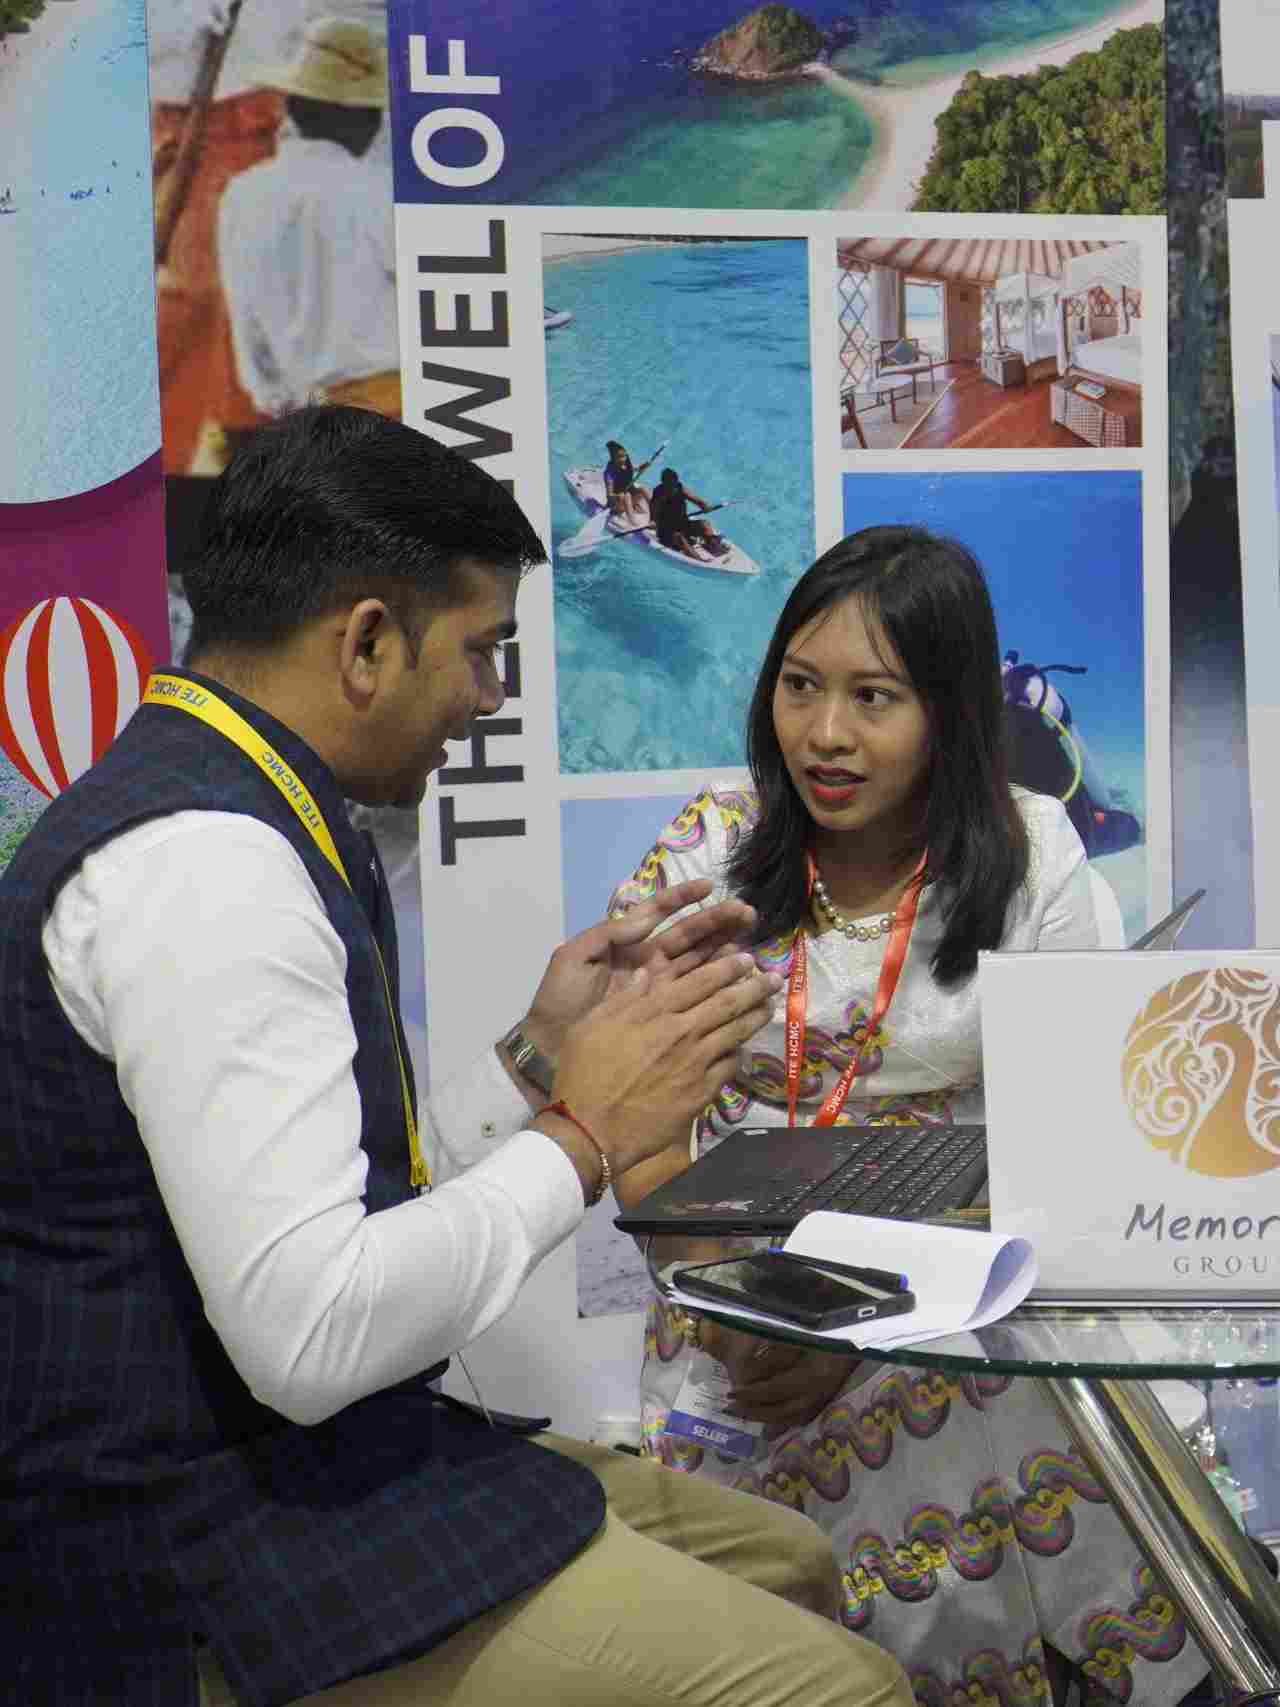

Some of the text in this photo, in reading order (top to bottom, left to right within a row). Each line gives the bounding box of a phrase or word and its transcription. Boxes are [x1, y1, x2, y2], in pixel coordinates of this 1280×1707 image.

[408, 34, 505, 188] OF
[261, 751, 304, 800] HCMC
[789, 1021, 800, 1057] HCMC
